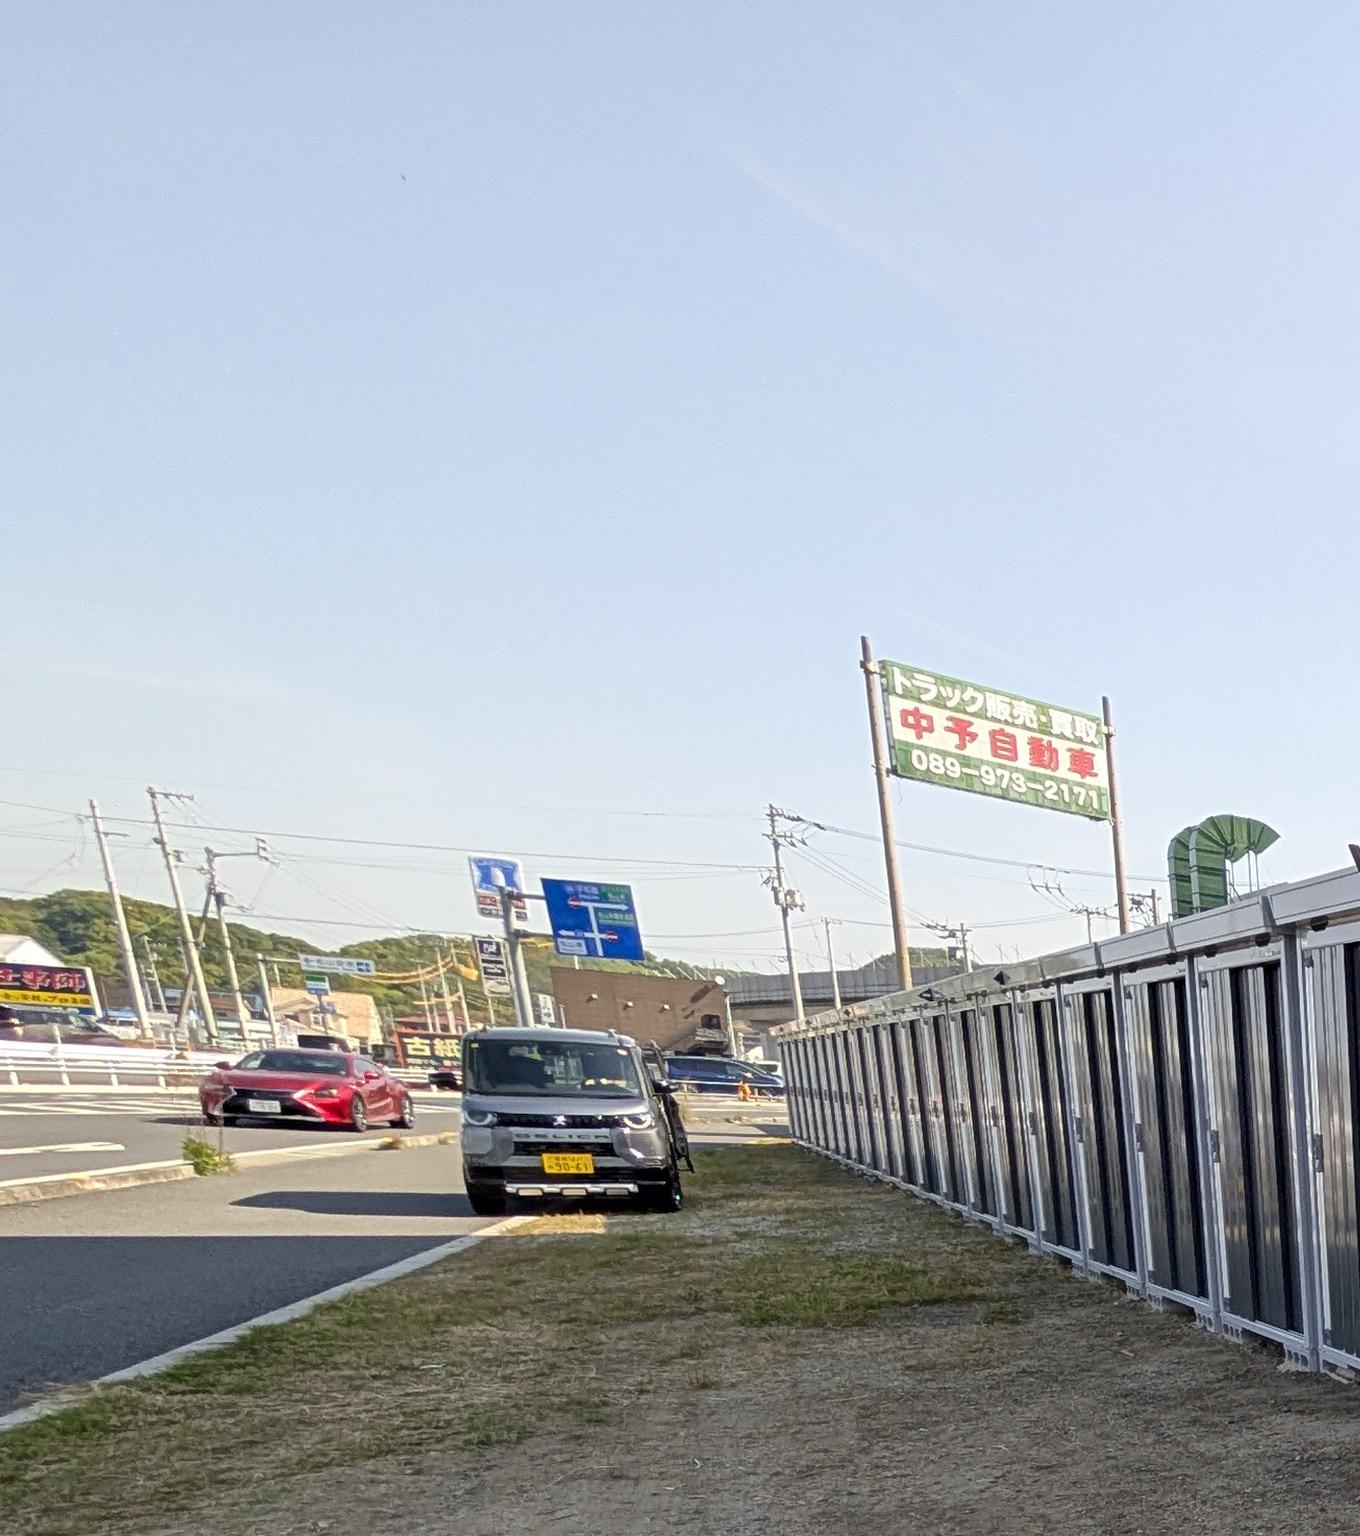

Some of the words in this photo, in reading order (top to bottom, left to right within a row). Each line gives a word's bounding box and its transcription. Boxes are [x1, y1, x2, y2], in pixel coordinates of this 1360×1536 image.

[893, 665, 1100, 745] トラック販売・買取
[899, 706, 1099, 779] 中予自動車
